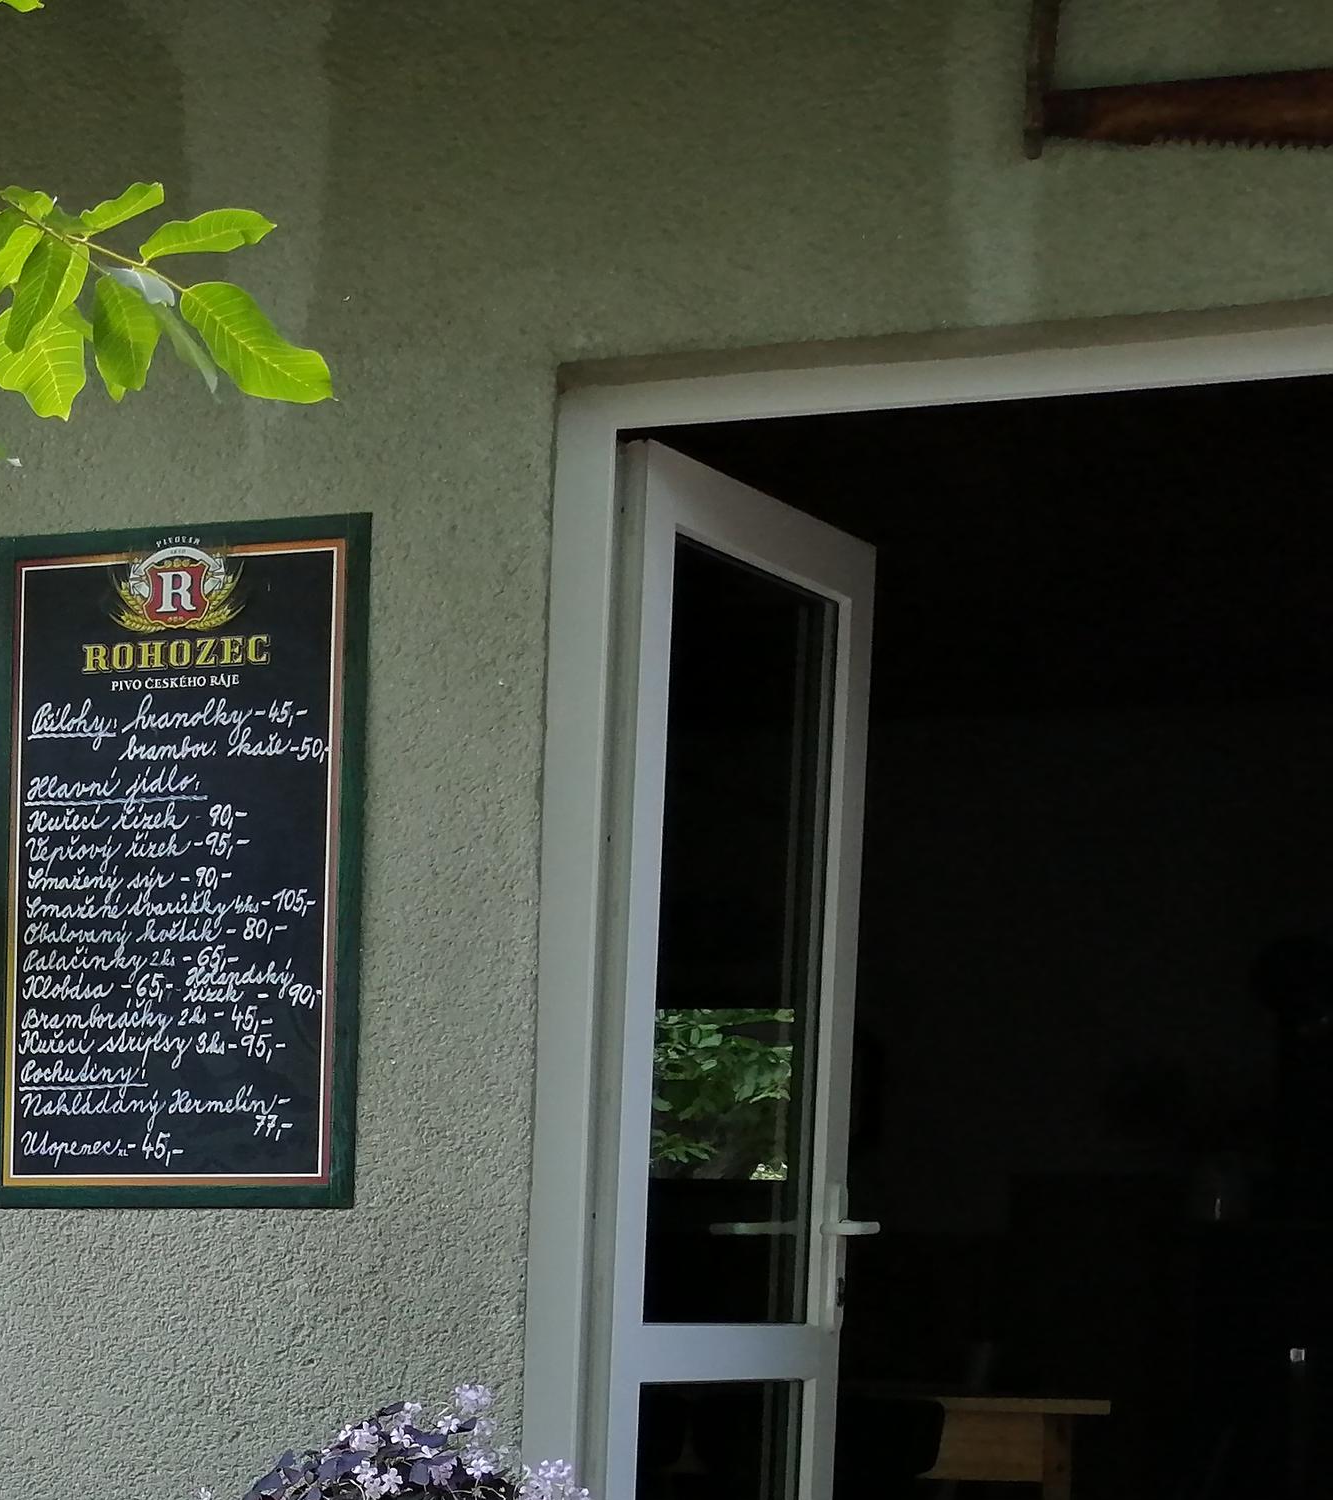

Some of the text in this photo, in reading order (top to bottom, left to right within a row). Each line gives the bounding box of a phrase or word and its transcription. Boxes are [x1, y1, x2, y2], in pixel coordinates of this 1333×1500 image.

[156, 570, 197, 613] R
[83, 634, 271, 675] ROHOZEC
[111, 673, 240, 691] PIVO ČESKÉHO RÁJE
[121, 693, 253, 746] hranolky
[26, 766, 121, 801] Hlavní
[26, 803, 111, 833] Kuřecí
[112, 801, 190, 831] řízek
[125, 831, 192, 859] řízek
[27, 865, 124, 903] Smažený
[126, 866, 175, 902] sýr
[136, 917, 223, 943] květák
[22, 972, 115, 1001] Klobása
[18, 1028, 96, 1055] Kuřecí
[20, 1088, 168, 1132] Nakládaný
